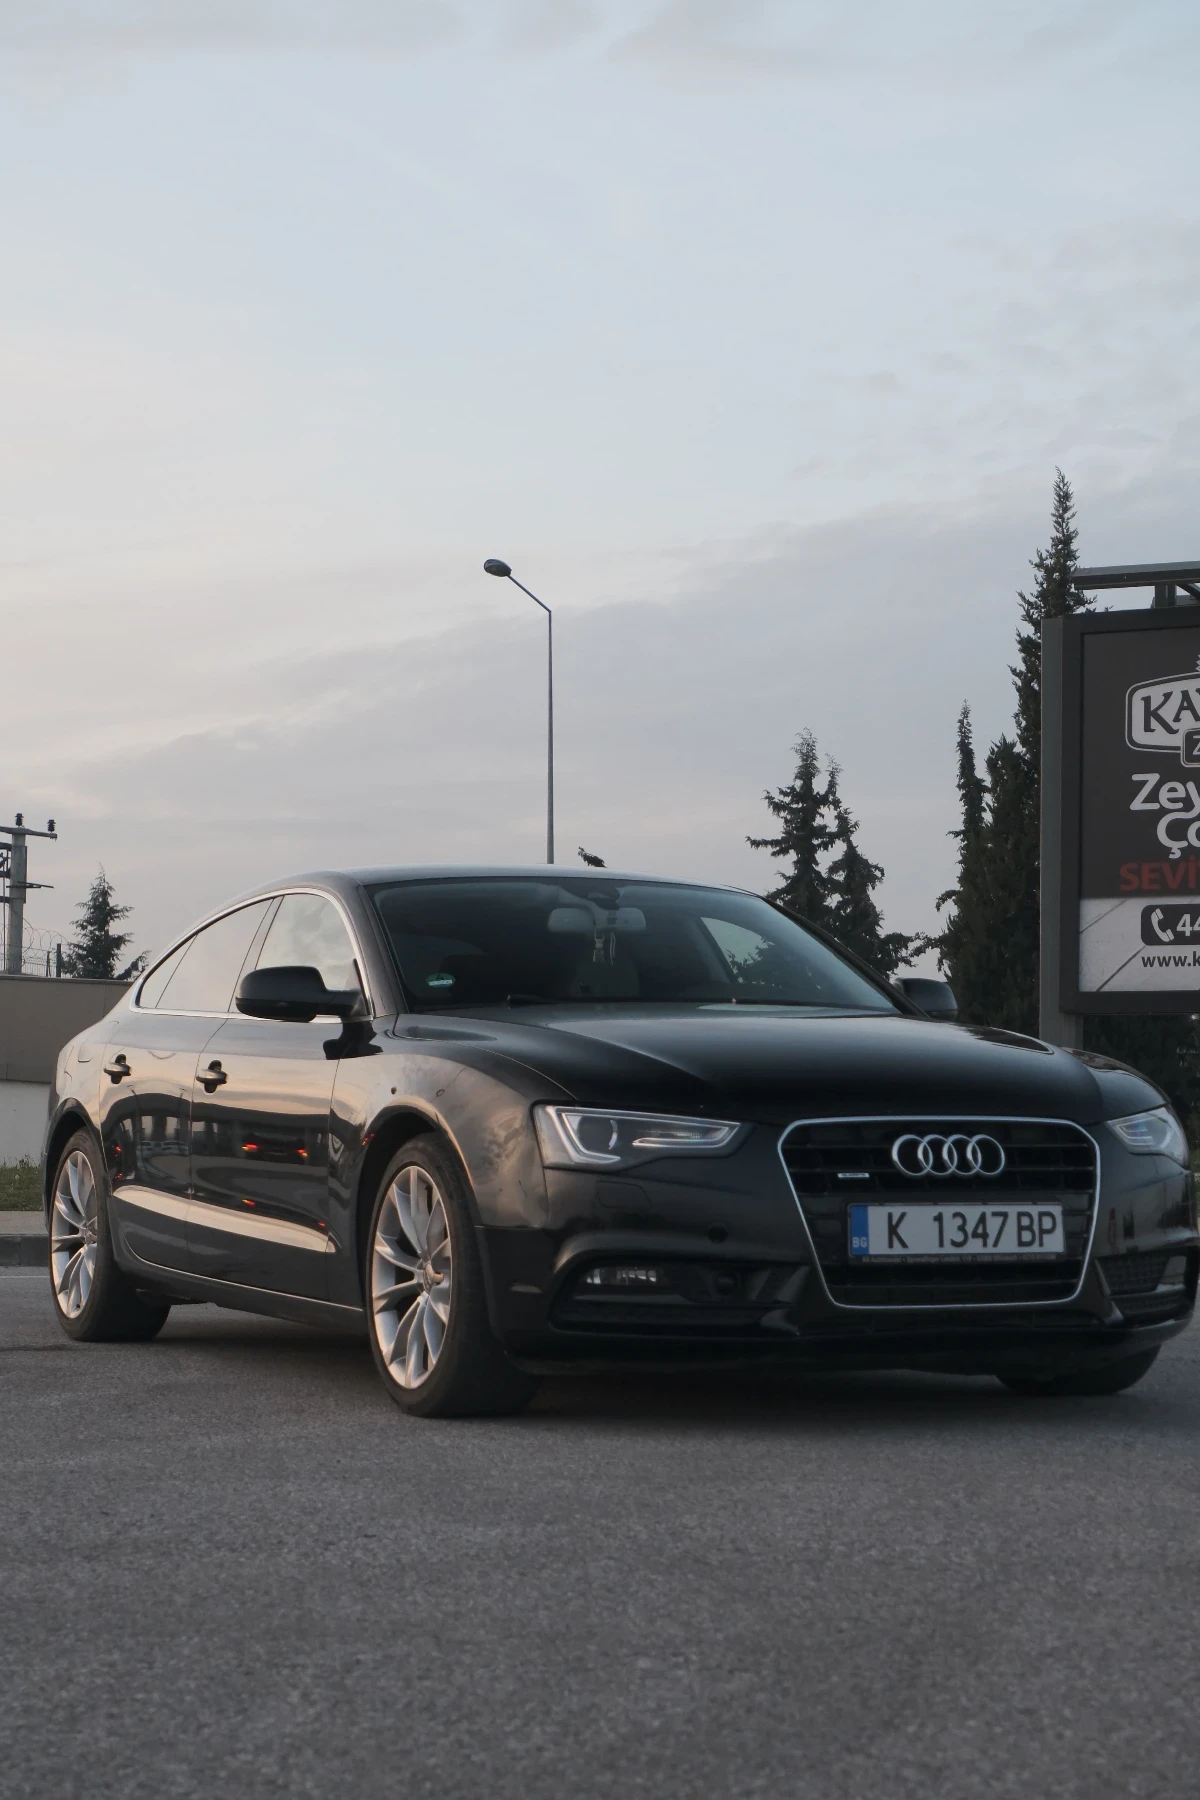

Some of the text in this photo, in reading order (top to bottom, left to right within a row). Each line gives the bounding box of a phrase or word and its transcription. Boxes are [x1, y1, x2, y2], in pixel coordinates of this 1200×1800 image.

[1141, 687, 1200, 735] KA
[1120, 854, 1200, 891] SEVİ
[852, 1236, 868, 1248] BG
[886, 1211, 1057, 1249] K 1347 BP
